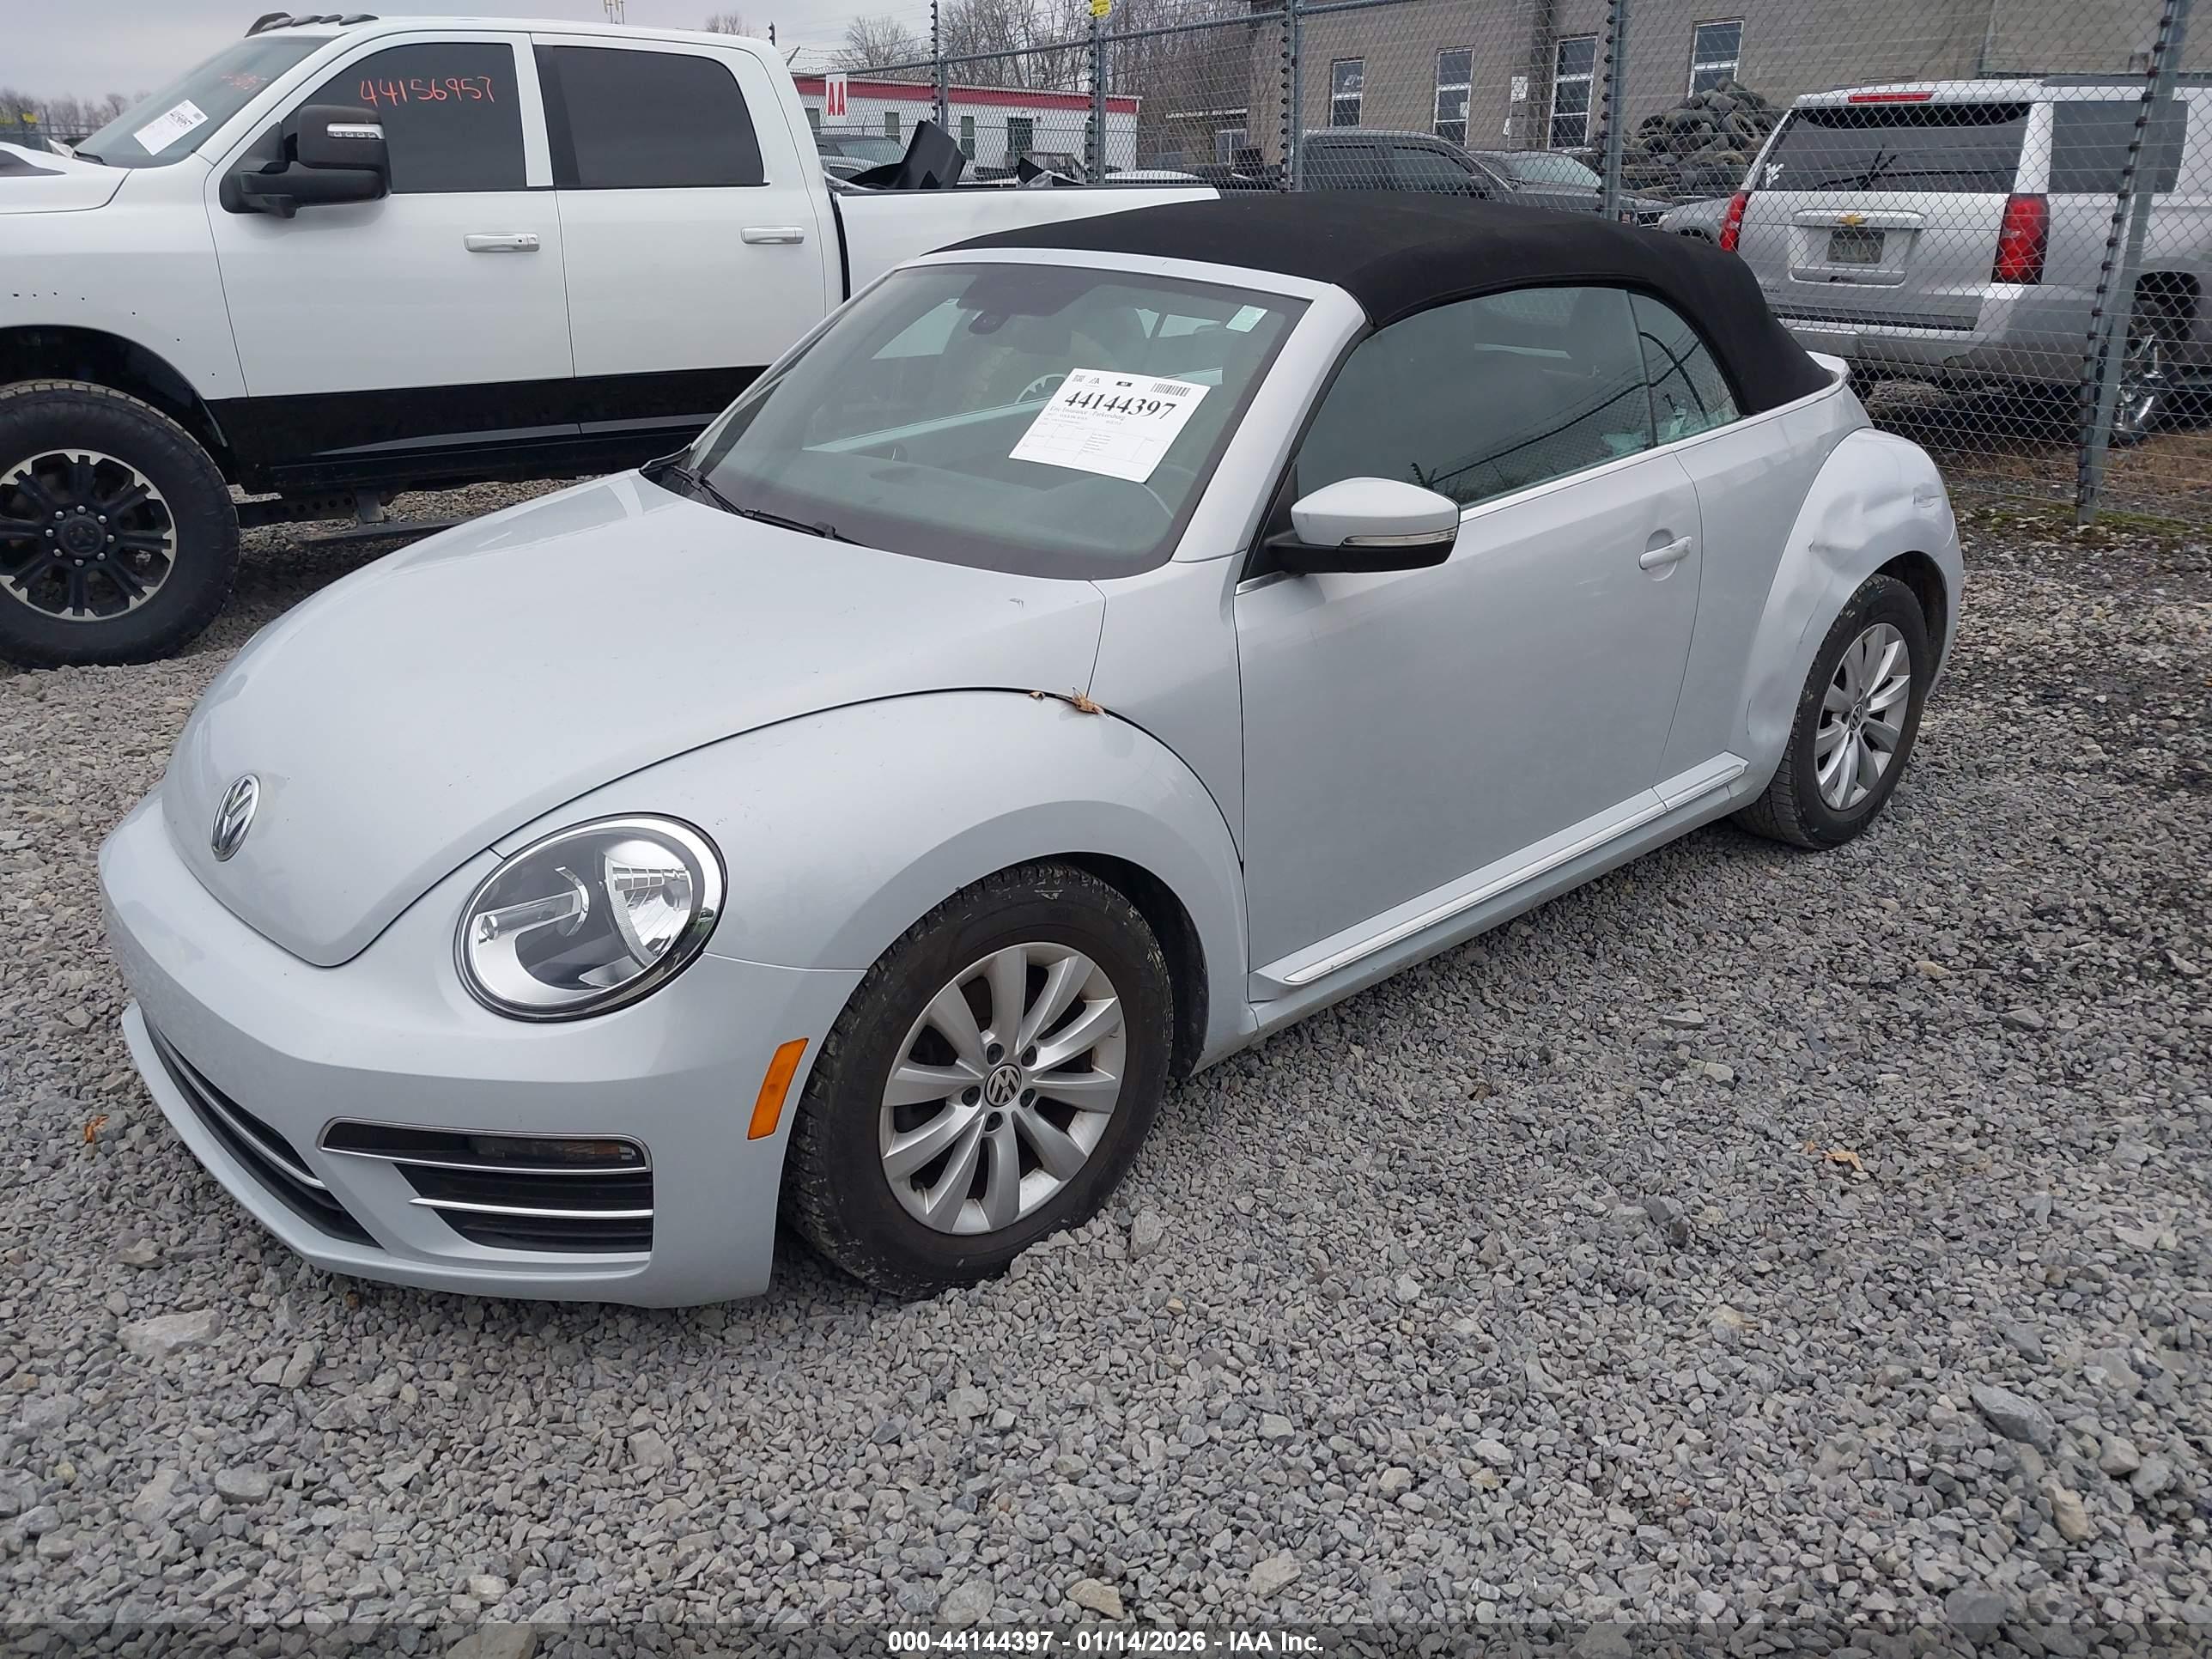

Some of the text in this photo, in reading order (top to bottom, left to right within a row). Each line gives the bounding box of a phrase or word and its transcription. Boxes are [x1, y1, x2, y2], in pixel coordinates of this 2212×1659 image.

[360, 76, 495, 107] 44156957
[827, 81, 846, 116] AA
[1065, 391, 1177, 419] 44144397
